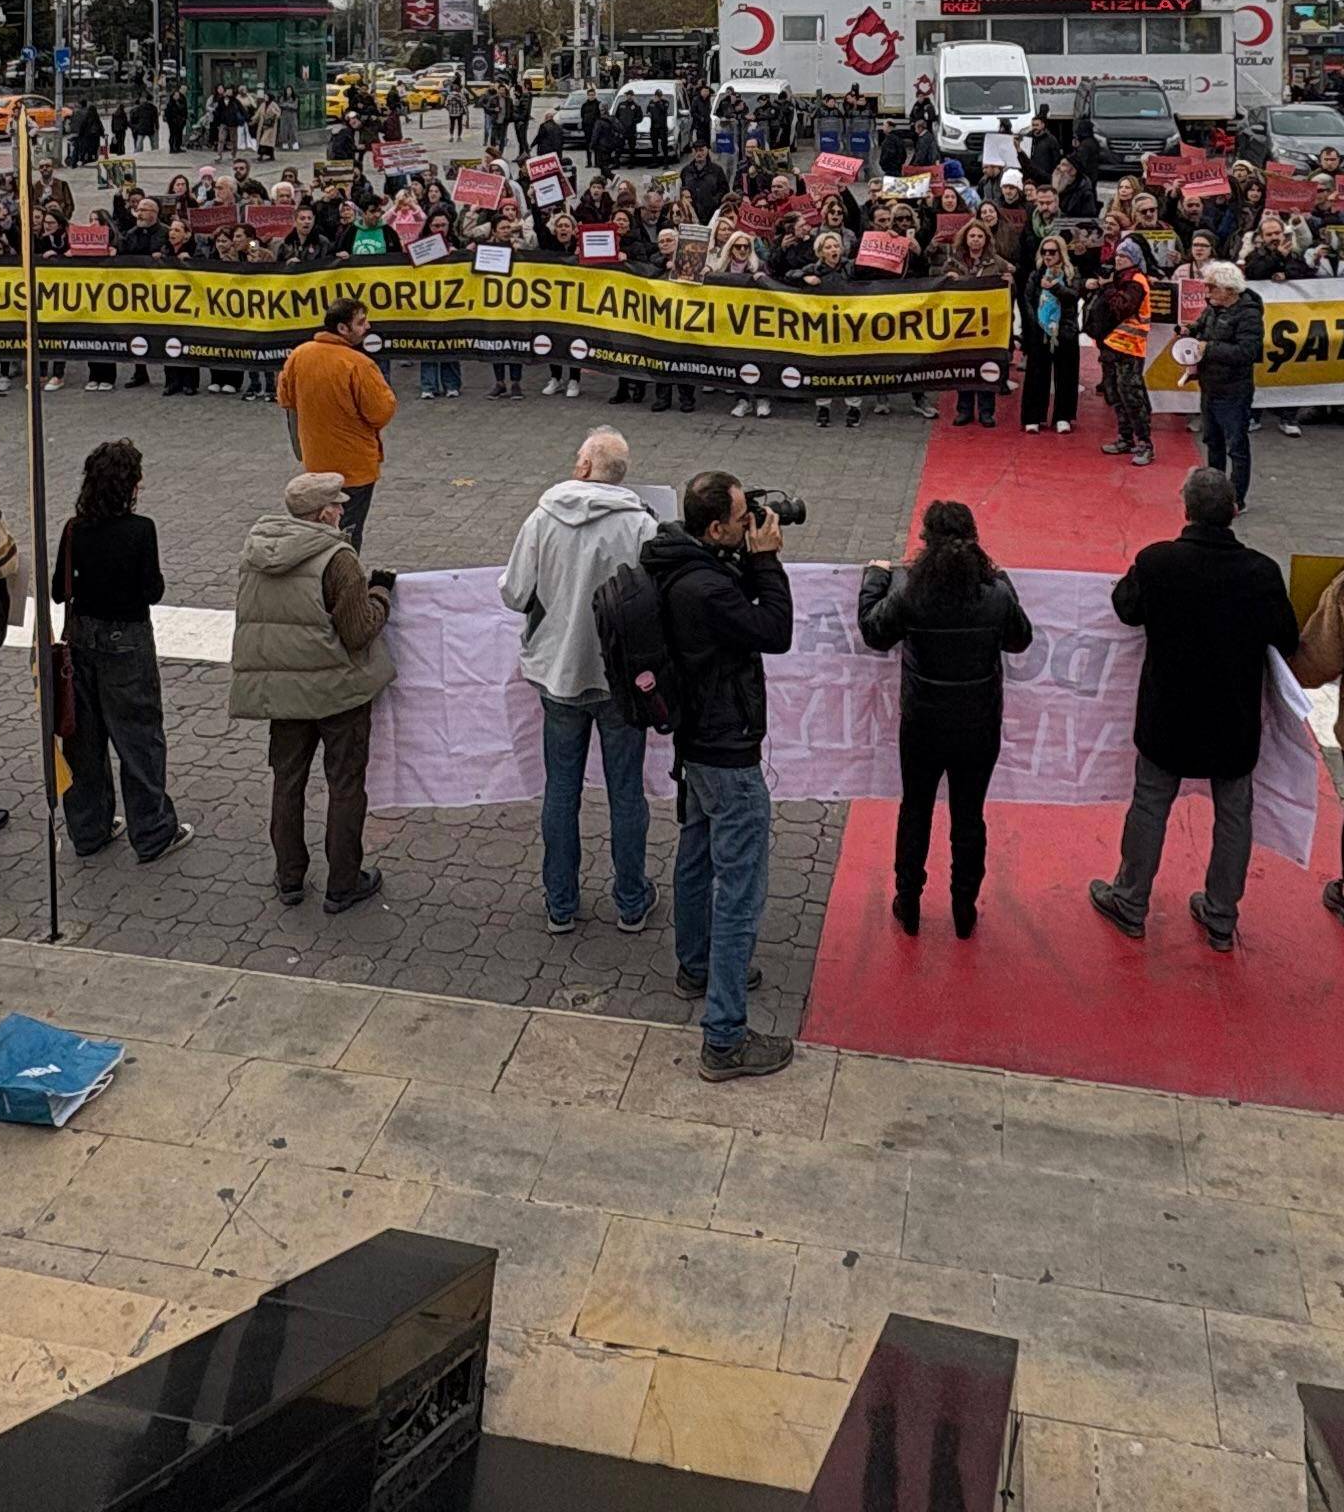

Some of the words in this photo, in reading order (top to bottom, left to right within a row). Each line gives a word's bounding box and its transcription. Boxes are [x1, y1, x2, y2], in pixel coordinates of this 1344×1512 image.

[730, 67, 776, 79] KIZILAY
[483, 277, 715, 333] DOSTLARIMIZI
[727, 303, 990, 344] VERMİYORUZ!
